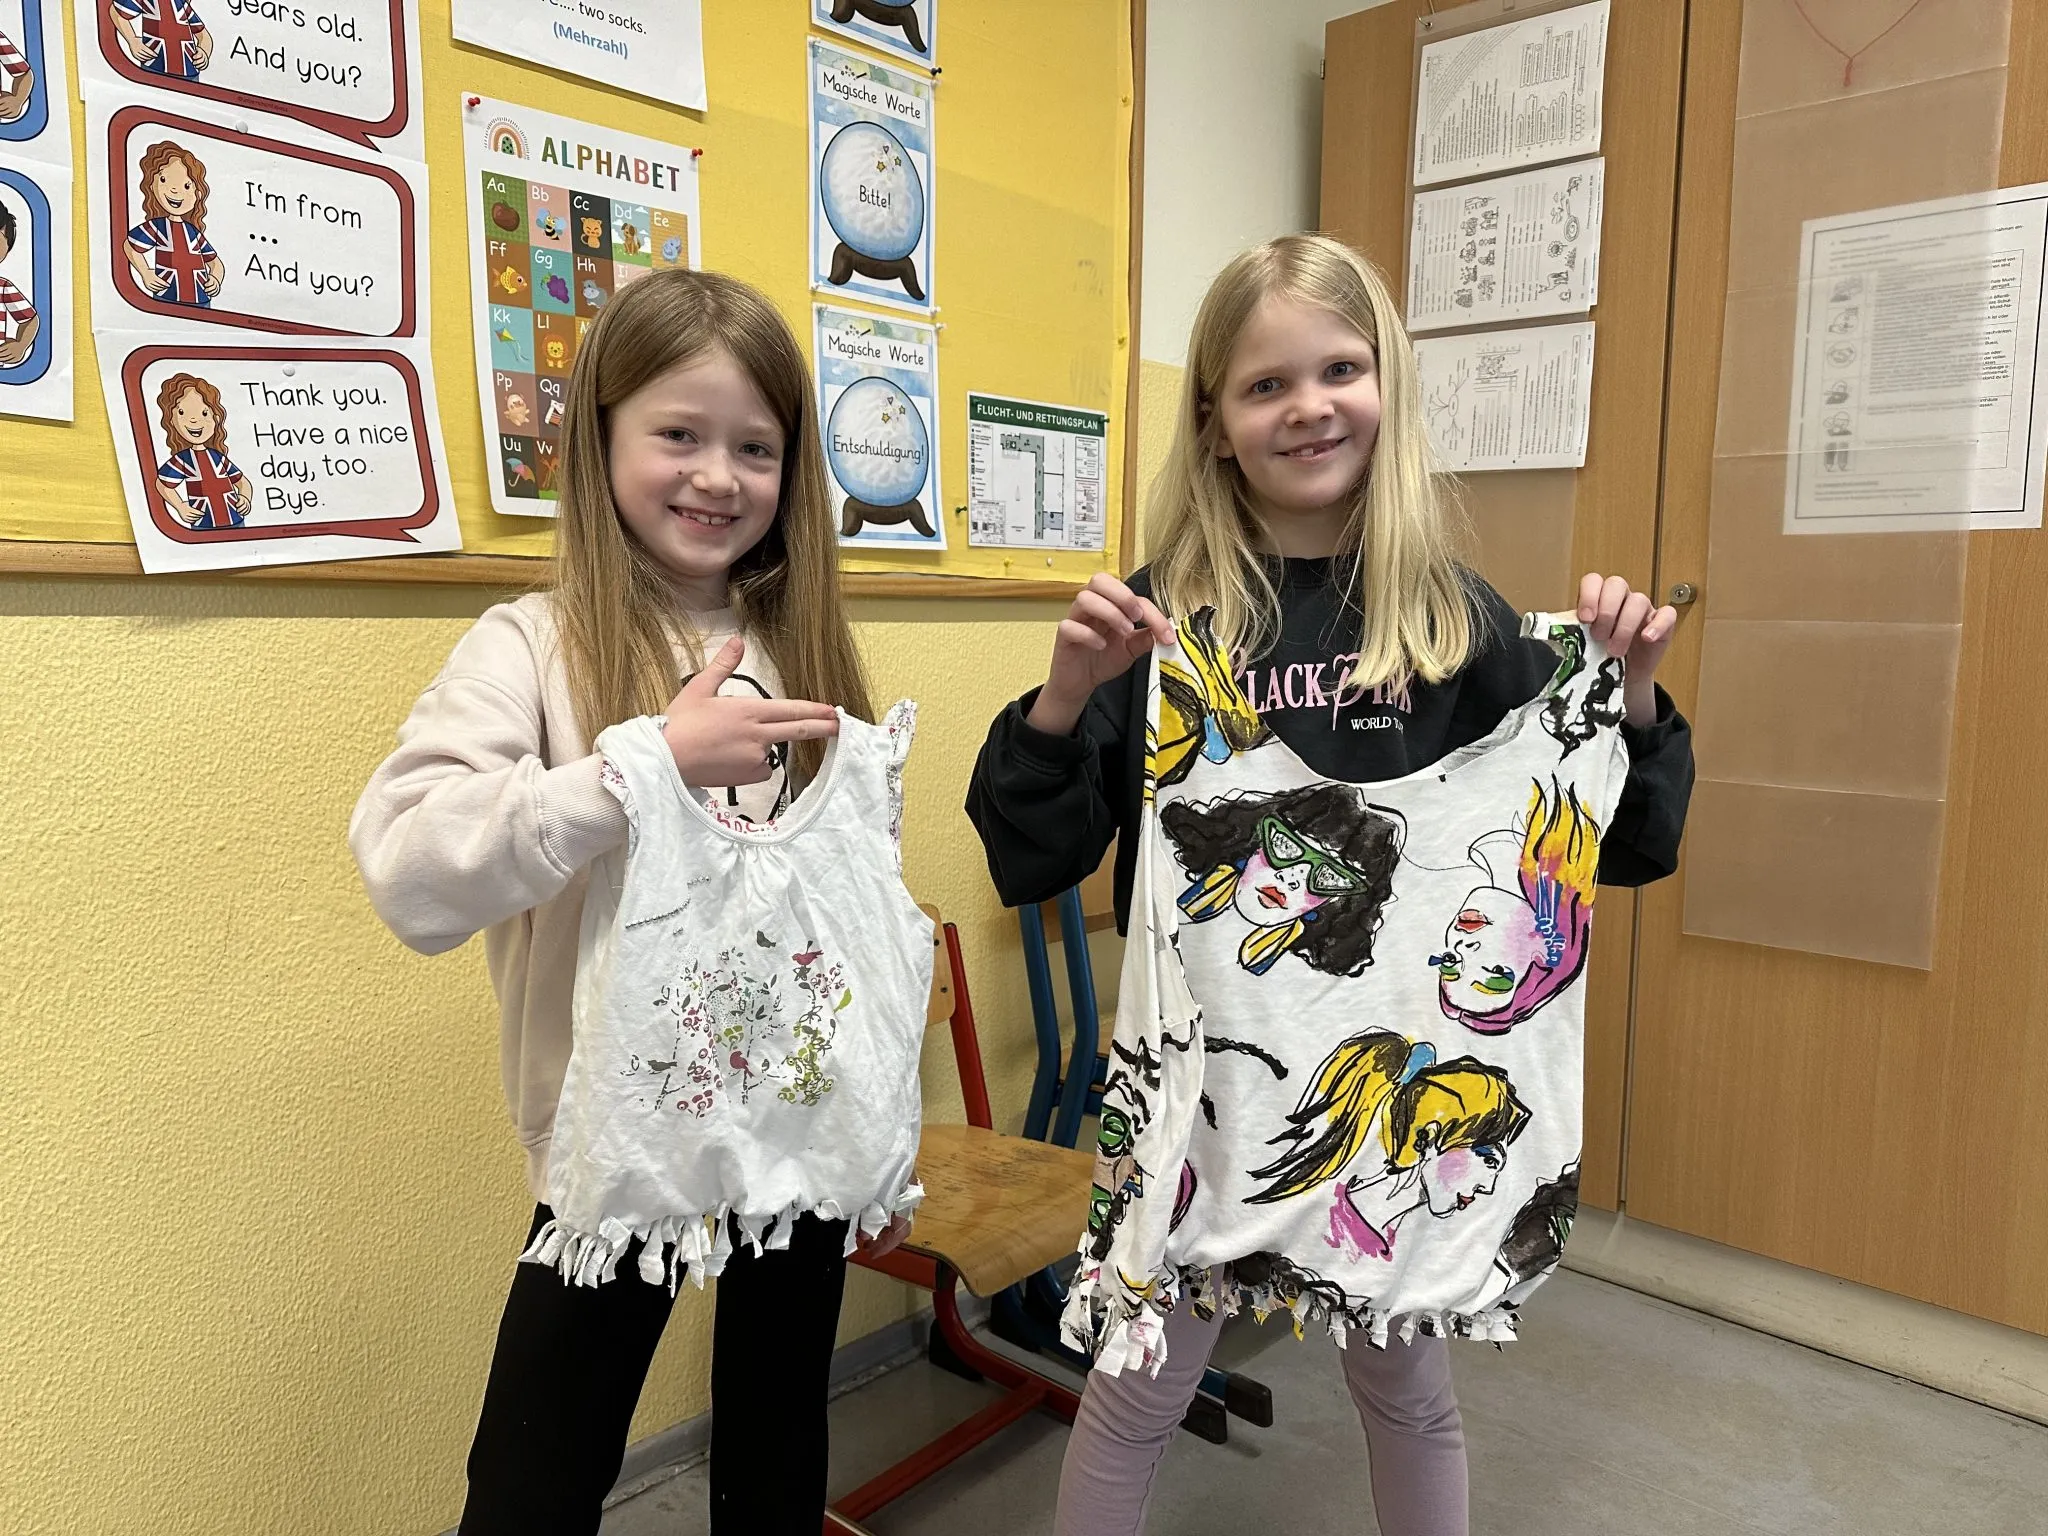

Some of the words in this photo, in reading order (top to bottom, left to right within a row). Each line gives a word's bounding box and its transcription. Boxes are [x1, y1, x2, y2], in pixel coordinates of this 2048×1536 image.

[227, 0, 306, 28] years
[317, 14, 363, 42] old.
[579, 1, 604, 21] two
[608, 13, 647, 35] socks.
[553, 21, 628, 60] (Mehrzahl)
[230, 36, 285, 72] And
[297, 58, 362, 88] you?
[823, 72, 877, 104] Magische
[885, 92, 921, 119] Worte
[541, 136, 680, 192] ALPHABET
[245, 181, 286, 214] I'm
[297, 195, 362, 229] from
[487, 177, 505, 194] Aa
[532, 186, 549, 202] Bb
[573, 196, 590, 211] Cc
[615, 204, 632, 220] Dd
[654, 212, 670, 228] Ee
[859, 184, 891, 209] Bitte!
[490, 241, 507, 257] Ff
[534, 250, 552, 270] Gg
[577, 256, 596, 273] Hh
[245, 254, 298, 287] And
[310, 272, 374, 298] you?
[493, 308, 511, 324] Kk
[537, 314, 549, 329] Ll
[828, 334, 881, 359] Magische
[889, 345, 924, 367] Worte
[240, 382, 323, 407] Thank
[333, 388, 387, 410] you.
[496, 372, 513, 391] Pp
[540, 378, 560, 398] Qq
[977, 404, 1014, 418] FLUCHT-
[1016, 411, 1034, 421] UND
[1036, 412, 1098, 430] RETTUNGSPLAN
[254, 422, 324, 447] Have
[335, 428, 349, 445] a
[360, 423, 408, 443] nice
[504, 437, 521, 453] Uu
[536, 440, 553, 455] Vv
[833, 434, 925, 465] Entschuldigung!
[260, 454, 316, 484] day,
[322, 454, 374, 476] too.
[266, 487, 326, 514] Bye.
[1350, 716, 1392, 731] WORLD
